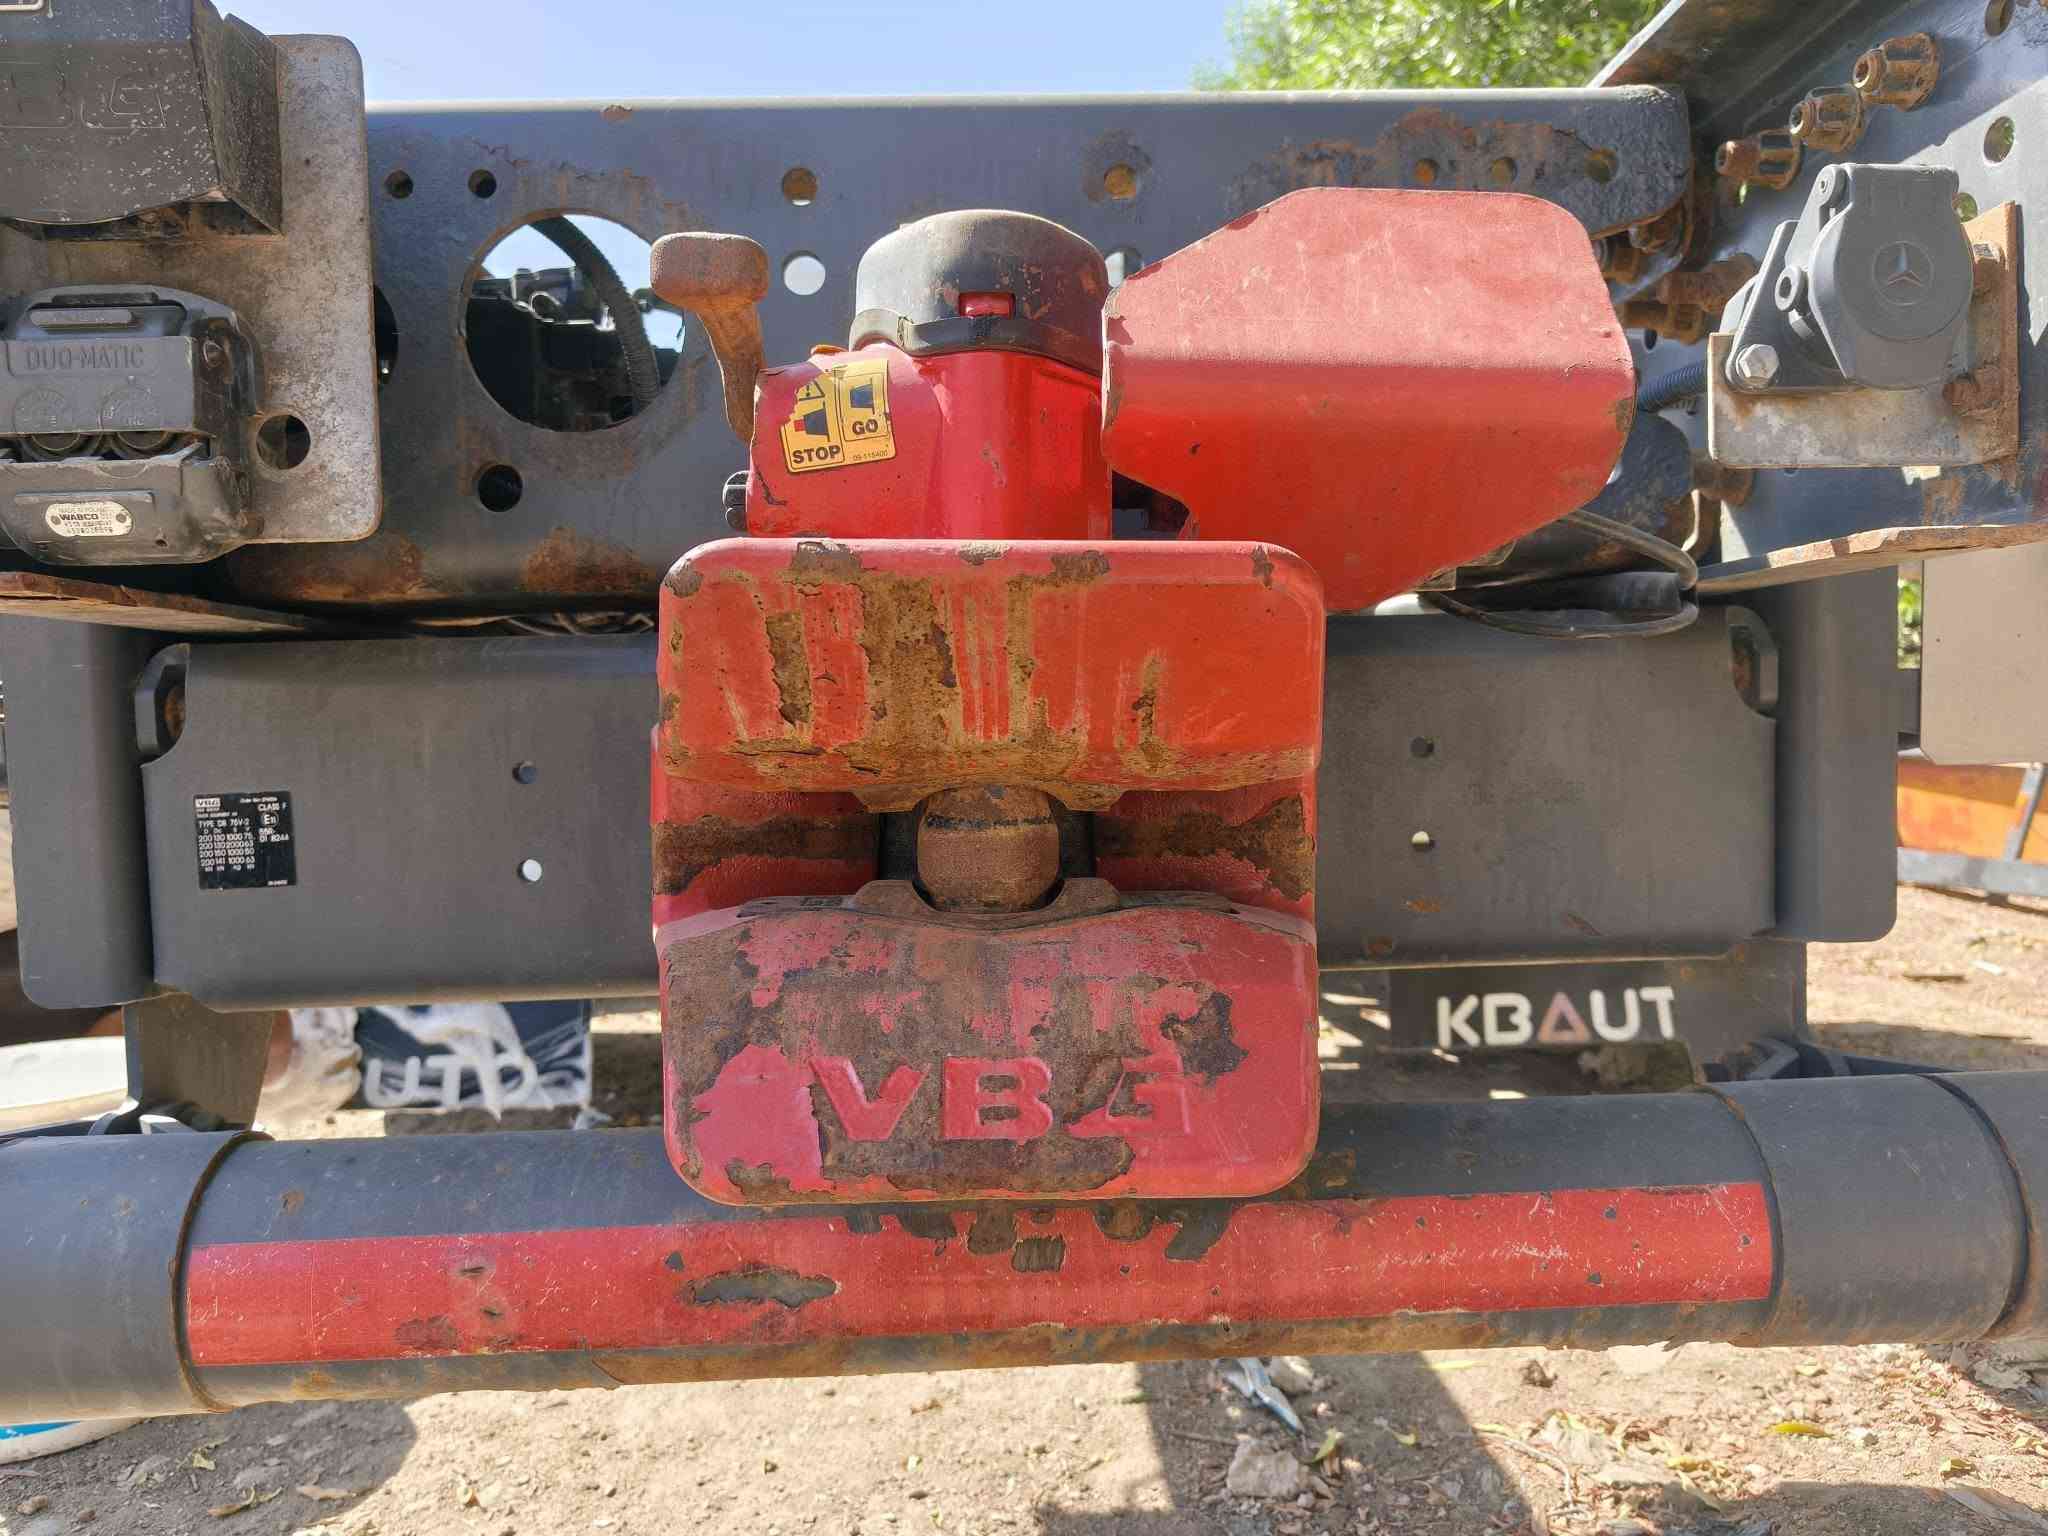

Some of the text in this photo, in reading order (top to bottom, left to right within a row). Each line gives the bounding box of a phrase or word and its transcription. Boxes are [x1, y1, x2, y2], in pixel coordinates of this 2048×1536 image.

[24, 345, 145, 370] DUO-MATIC
[852, 418, 880, 436] GO
[792, 445, 841, 464] STOP
[59, 513, 99, 521] WABCO
[258, 803, 280, 812] CLASS
[199, 820, 214, 828] TYPE
[227, 833, 243, 841] 1000
[199, 842, 213, 850] 200
[226, 841, 244, 849] 2000
[245, 840, 254, 848] 63
[200, 850, 214, 858] 200
[227, 848, 244, 856] 1000
[201, 858, 215, 866] 200
[246, 856, 255, 864] 63
[807, 1055, 1192, 1141] VBG
